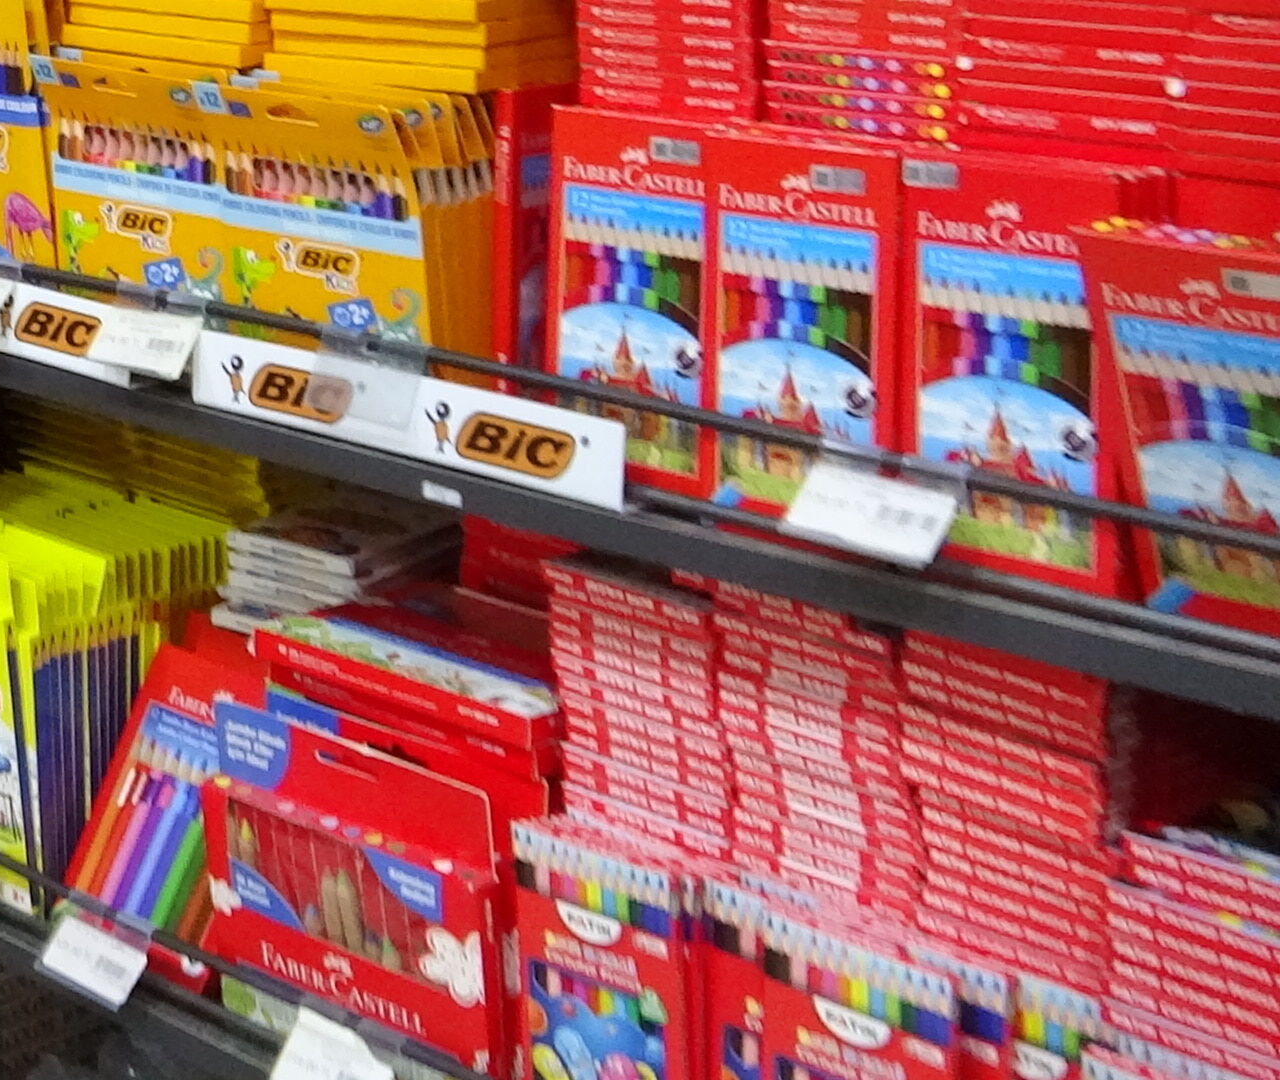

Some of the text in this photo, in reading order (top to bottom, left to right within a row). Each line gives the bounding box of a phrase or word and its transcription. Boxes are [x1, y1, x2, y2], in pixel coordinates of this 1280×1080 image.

[563, 155, 706, 197] FABER-CASTELL
[718, 183, 878, 228] FABER-CASTELL
[1101, 282, 1280, 332] FABER-CASTE
[259, 938, 428, 1038] FABER-CASTELL
